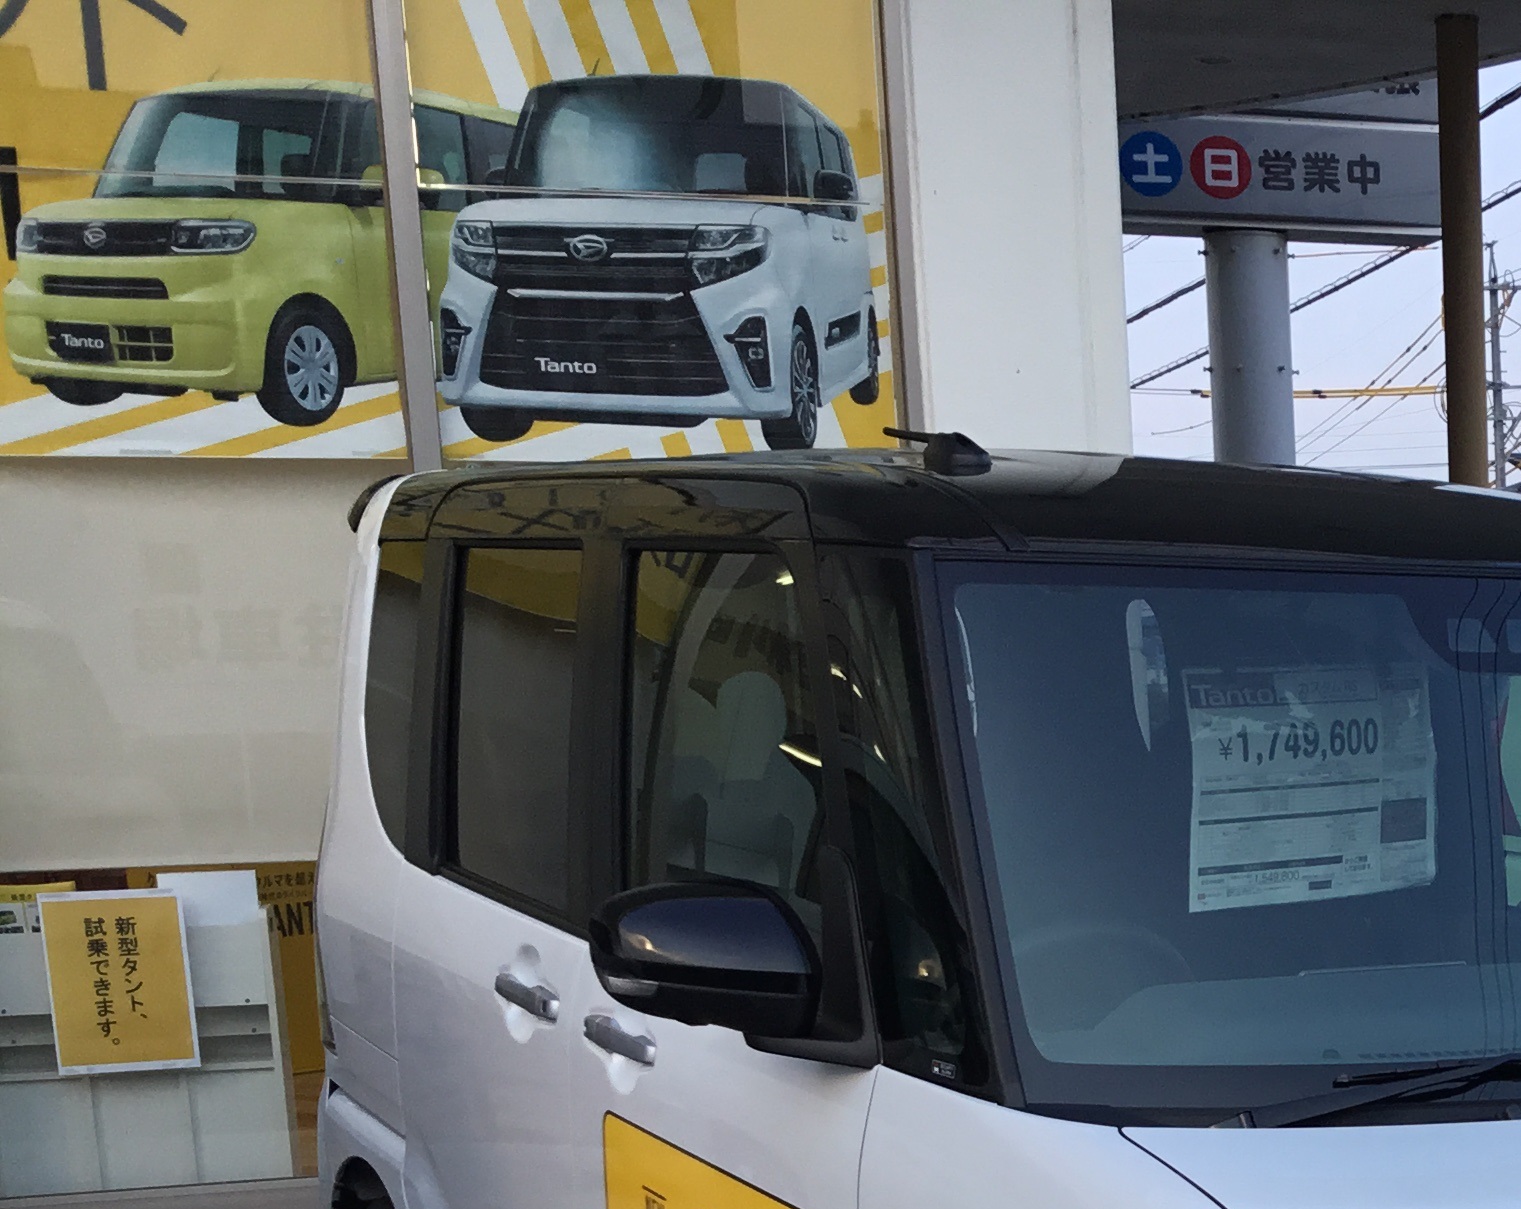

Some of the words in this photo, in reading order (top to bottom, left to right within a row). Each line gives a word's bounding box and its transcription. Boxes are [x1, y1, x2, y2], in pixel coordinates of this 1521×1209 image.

[1132, 142, 1172, 184] 土
[1203, 148, 1239, 188] 日
[1258, 148, 1381, 196] 営業中
[61, 333, 104, 349] Tanto
[534, 357, 597, 374] Tanto
[83, 917, 121, 1046] 試乗できます。
[113, 915, 148, 1019] 新型タント、
